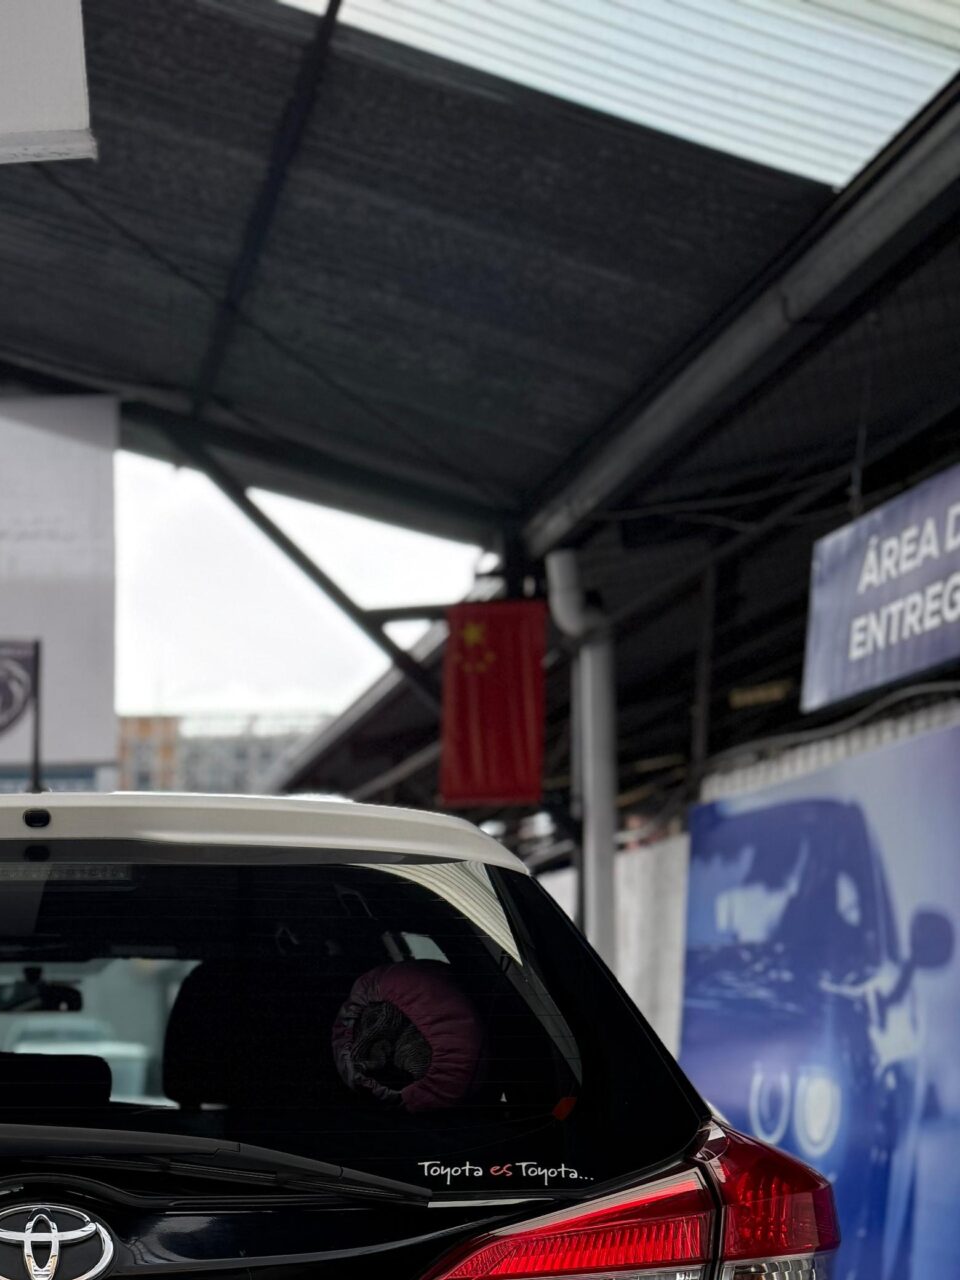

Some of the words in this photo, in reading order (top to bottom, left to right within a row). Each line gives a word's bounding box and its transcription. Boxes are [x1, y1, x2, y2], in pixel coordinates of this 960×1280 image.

[857, 517, 939, 594] ÁREA
[418, 1161, 483, 1185] Toyota
[490, 1163, 513, 1177] es
